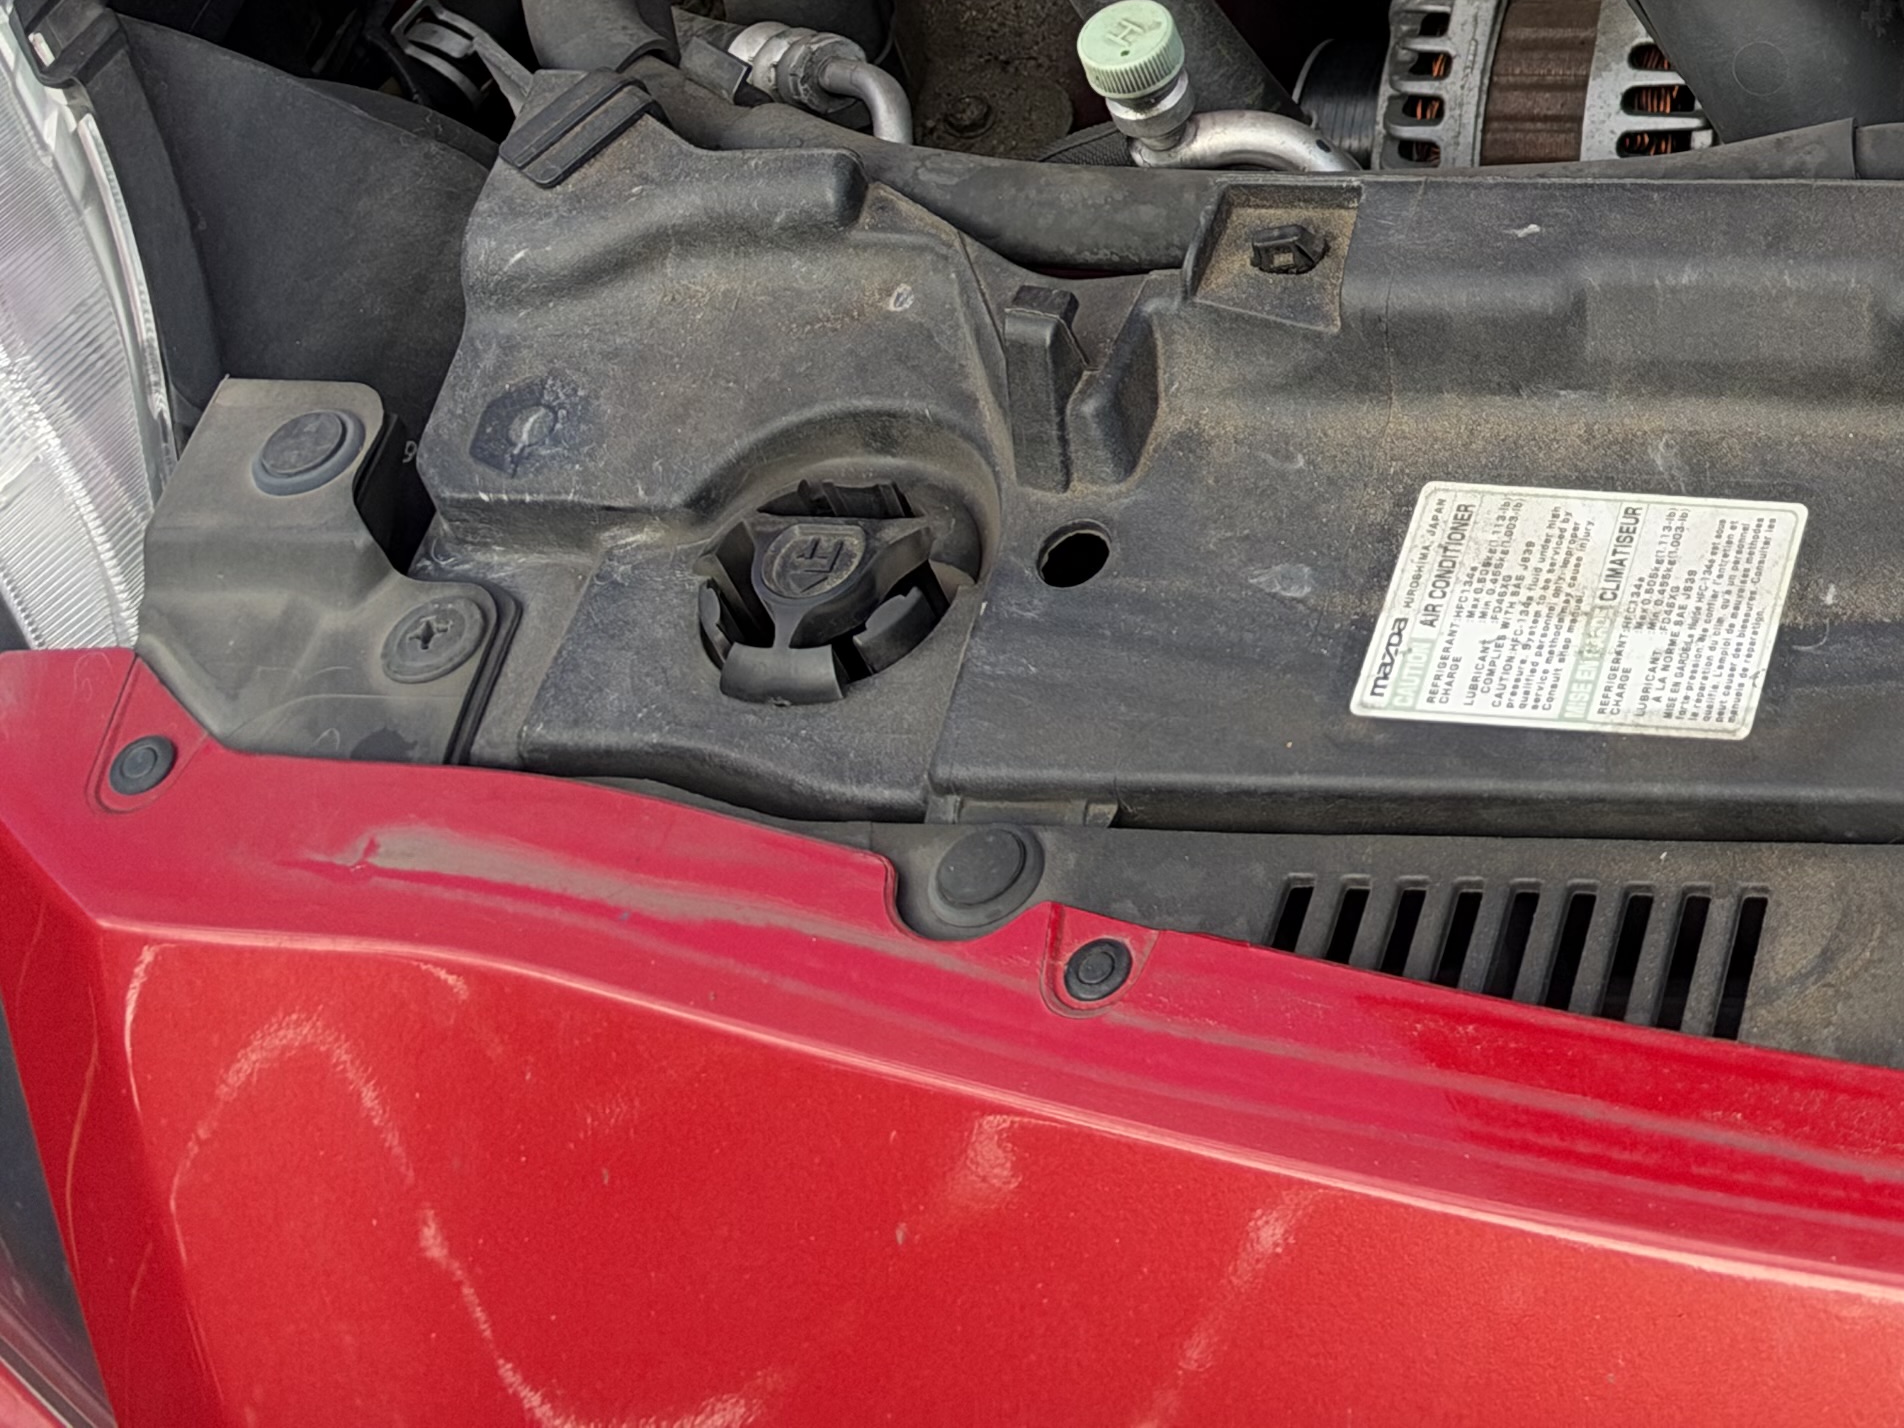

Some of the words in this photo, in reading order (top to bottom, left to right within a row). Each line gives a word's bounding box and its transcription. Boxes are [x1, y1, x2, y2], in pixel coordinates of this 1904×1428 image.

[1558, 510, 1574, 523] by
[1727, 519, 1739, 530] et
[1426, 502, 1476, 599] CONDITIONER
[1526, 566, 1543, 591] fluid
[1535, 532, 1554, 563] under
[1545, 505, 1563, 529] high
[1543, 526, 1568, 574] serviced
[1368, 616, 1409, 697] mazda
[1424, 497, 1448, 537] JAPAN
[1534, 593, 1548, 605] to
[1538, 577, 1553, 591] be
[1573, 658, 1600, 680] EN
[1597, 505, 1643, 602] CLIMATISEUR
[1729, 640, 1743, 659] des
[1763, 517, 1777, 532] les
[1418, 602, 1444, 628] AIR
[1478, 633, 1507, 693] COMPLIES
[1498, 600, 1517, 629] WITH
[1508, 573, 1526, 597] SAE
[1527, 667, 1550, 710] service
[1566, 555, 1584, 589] cause
[1672, 603, 1688, 626] SAE
[1723, 621, 1736, 634] de
[1660, 630, 1681, 672] NORME
[1705, 638, 1719, 652] du
[1391, 639, 1433, 707] CAUTION
[1437, 655, 1463, 704] CHARGE
[1462, 638, 1493, 706] LUBRICANT
[1516, 660, 1541, 709] qualified
[1540, 667, 1563, 711] Consult
[1554, 636, 1572, 664] shop
[1609, 666, 1633, 716] CHARGE
[1634, 649, 1663, 717] LUBRICANT
[1654, 676, 1668, 691] LA
[1669, 680, 1682, 693] EN
[1737, 665, 1750, 679] de
[1662, 696, 1678, 719] MISE
